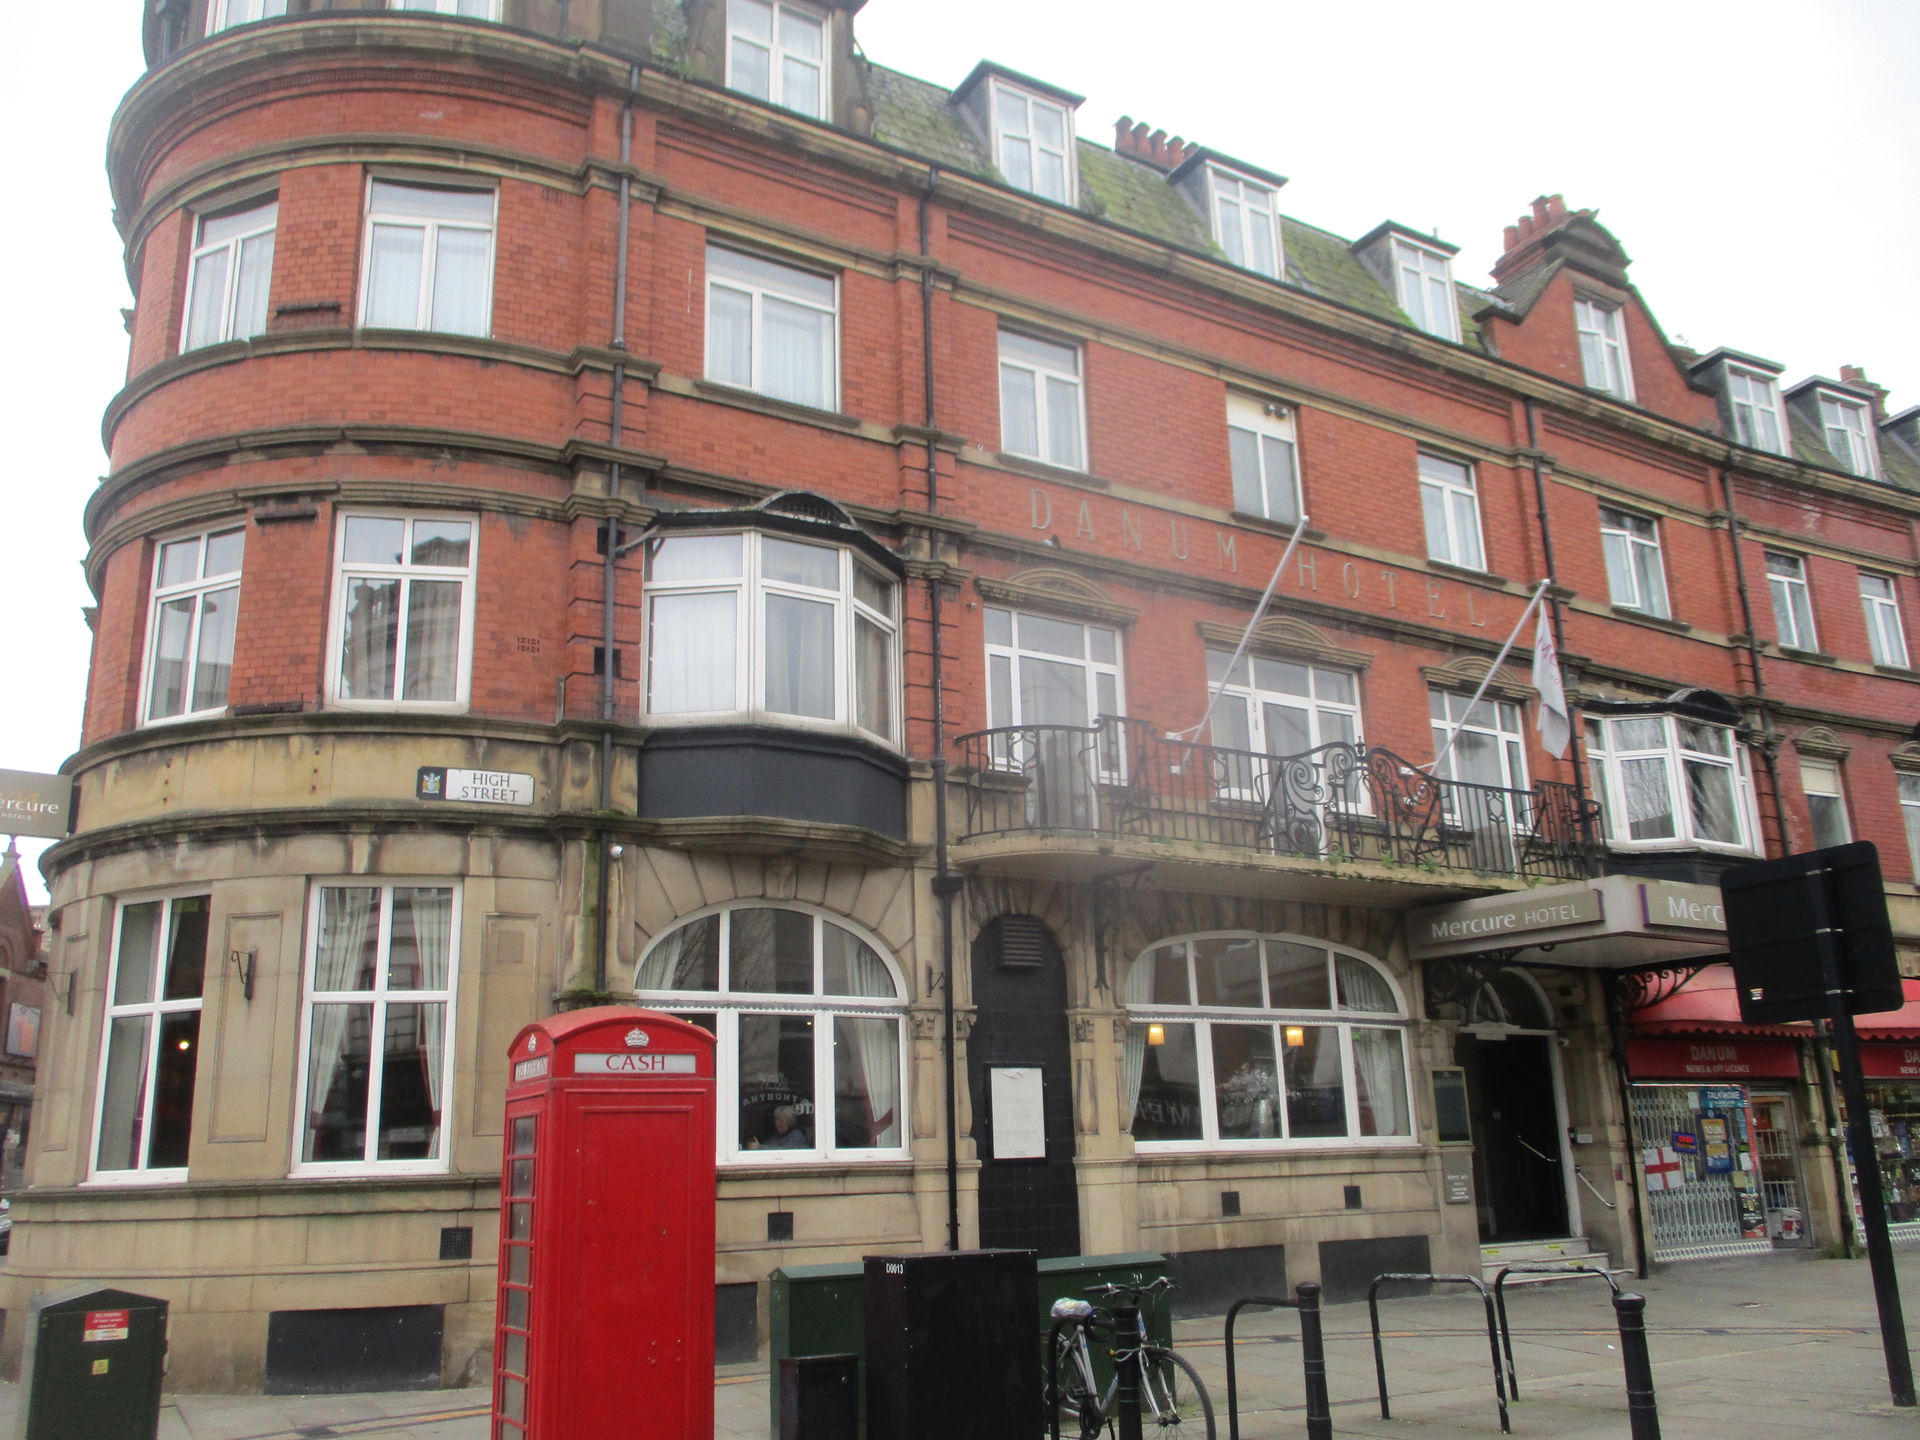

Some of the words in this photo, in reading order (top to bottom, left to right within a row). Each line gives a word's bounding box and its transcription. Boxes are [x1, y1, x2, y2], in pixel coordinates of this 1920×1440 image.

[1029, 487, 1238, 573] DANUM
[1297, 550, 1486, 627] HOTEL
[472, 772, 511, 788] HIGH
[461, 785, 520, 803] STREET
[1431, 912, 1517, 939] Mercure
[1523, 903, 1582, 925] HOTEL
[605, 1053, 666, 1071] CASH
[1691, 1046, 1736, 1060] DANUM
